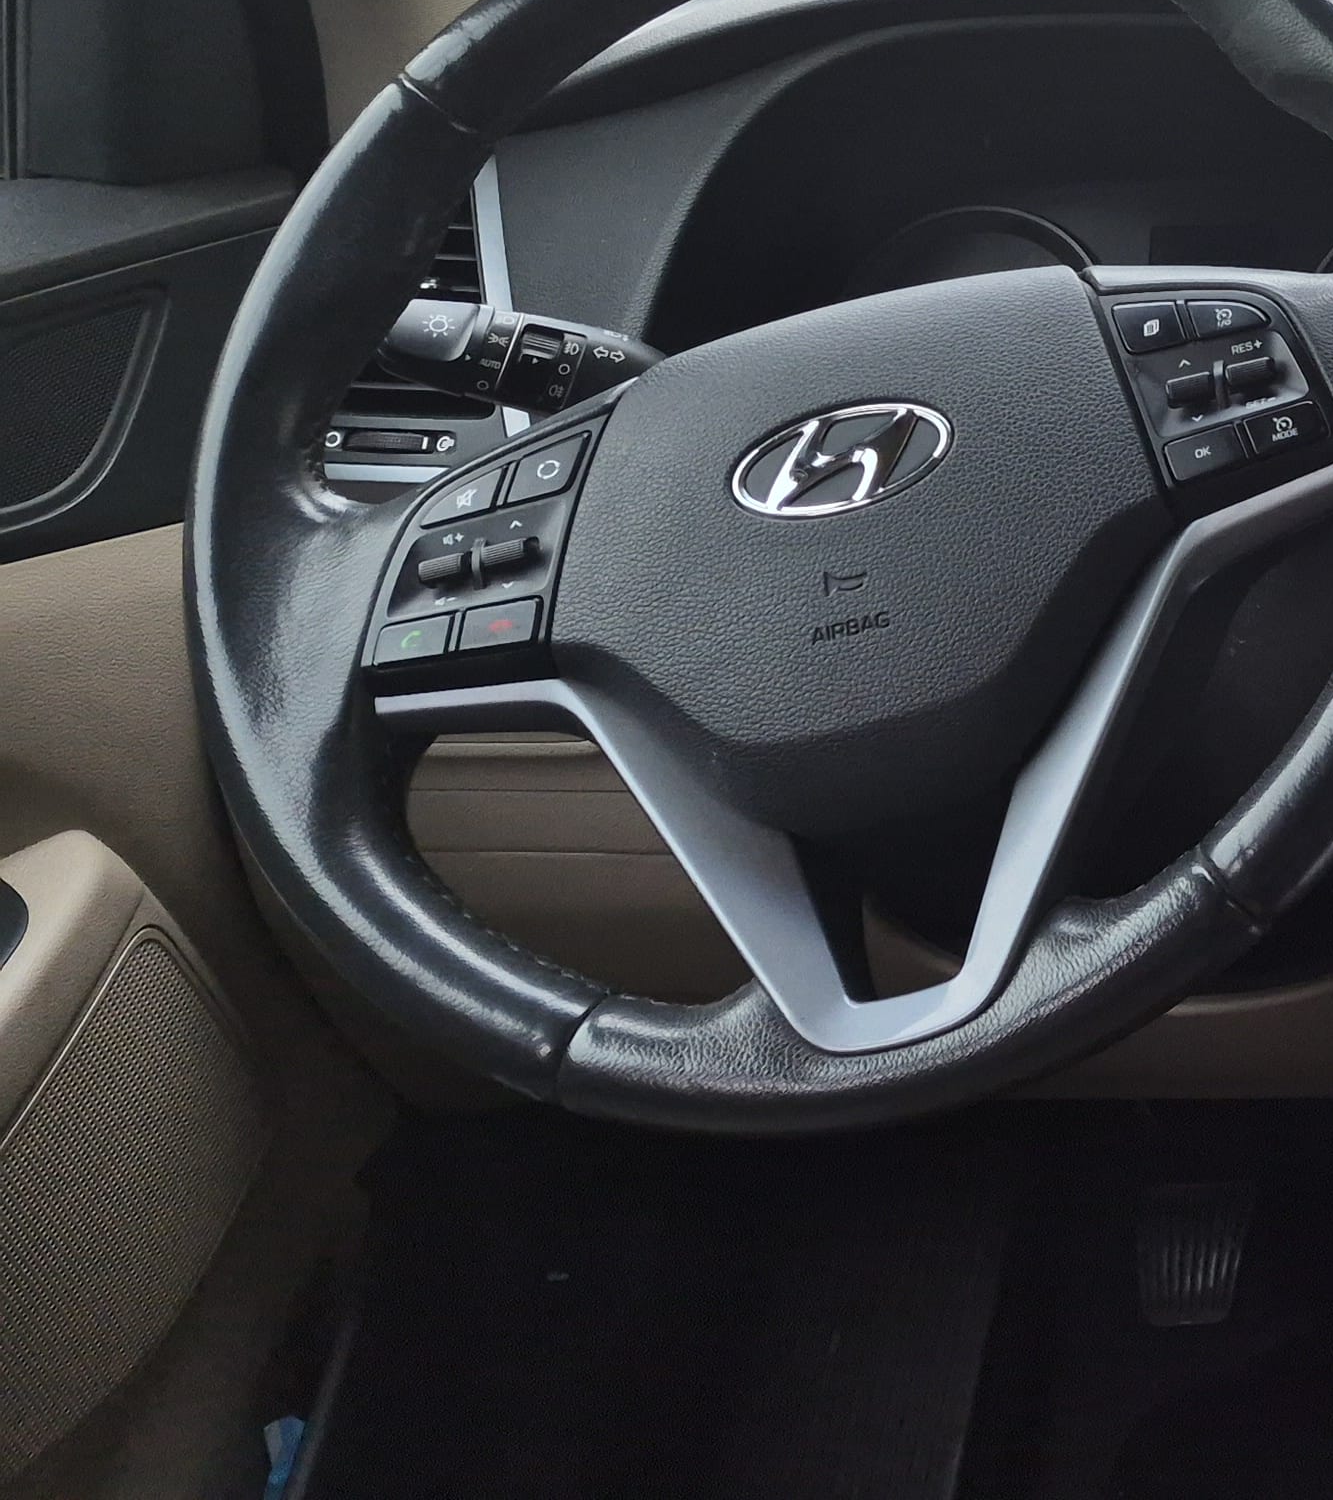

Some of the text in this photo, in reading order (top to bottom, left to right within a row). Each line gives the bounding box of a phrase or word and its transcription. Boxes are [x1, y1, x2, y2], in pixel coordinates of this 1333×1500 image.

[479, 358, 501, 370] AUTO
[1272, 428, 1298, 442] MODE
[1194, 446, 1212, 459] OK
[811, 611, 890, 645] AIRBAG
